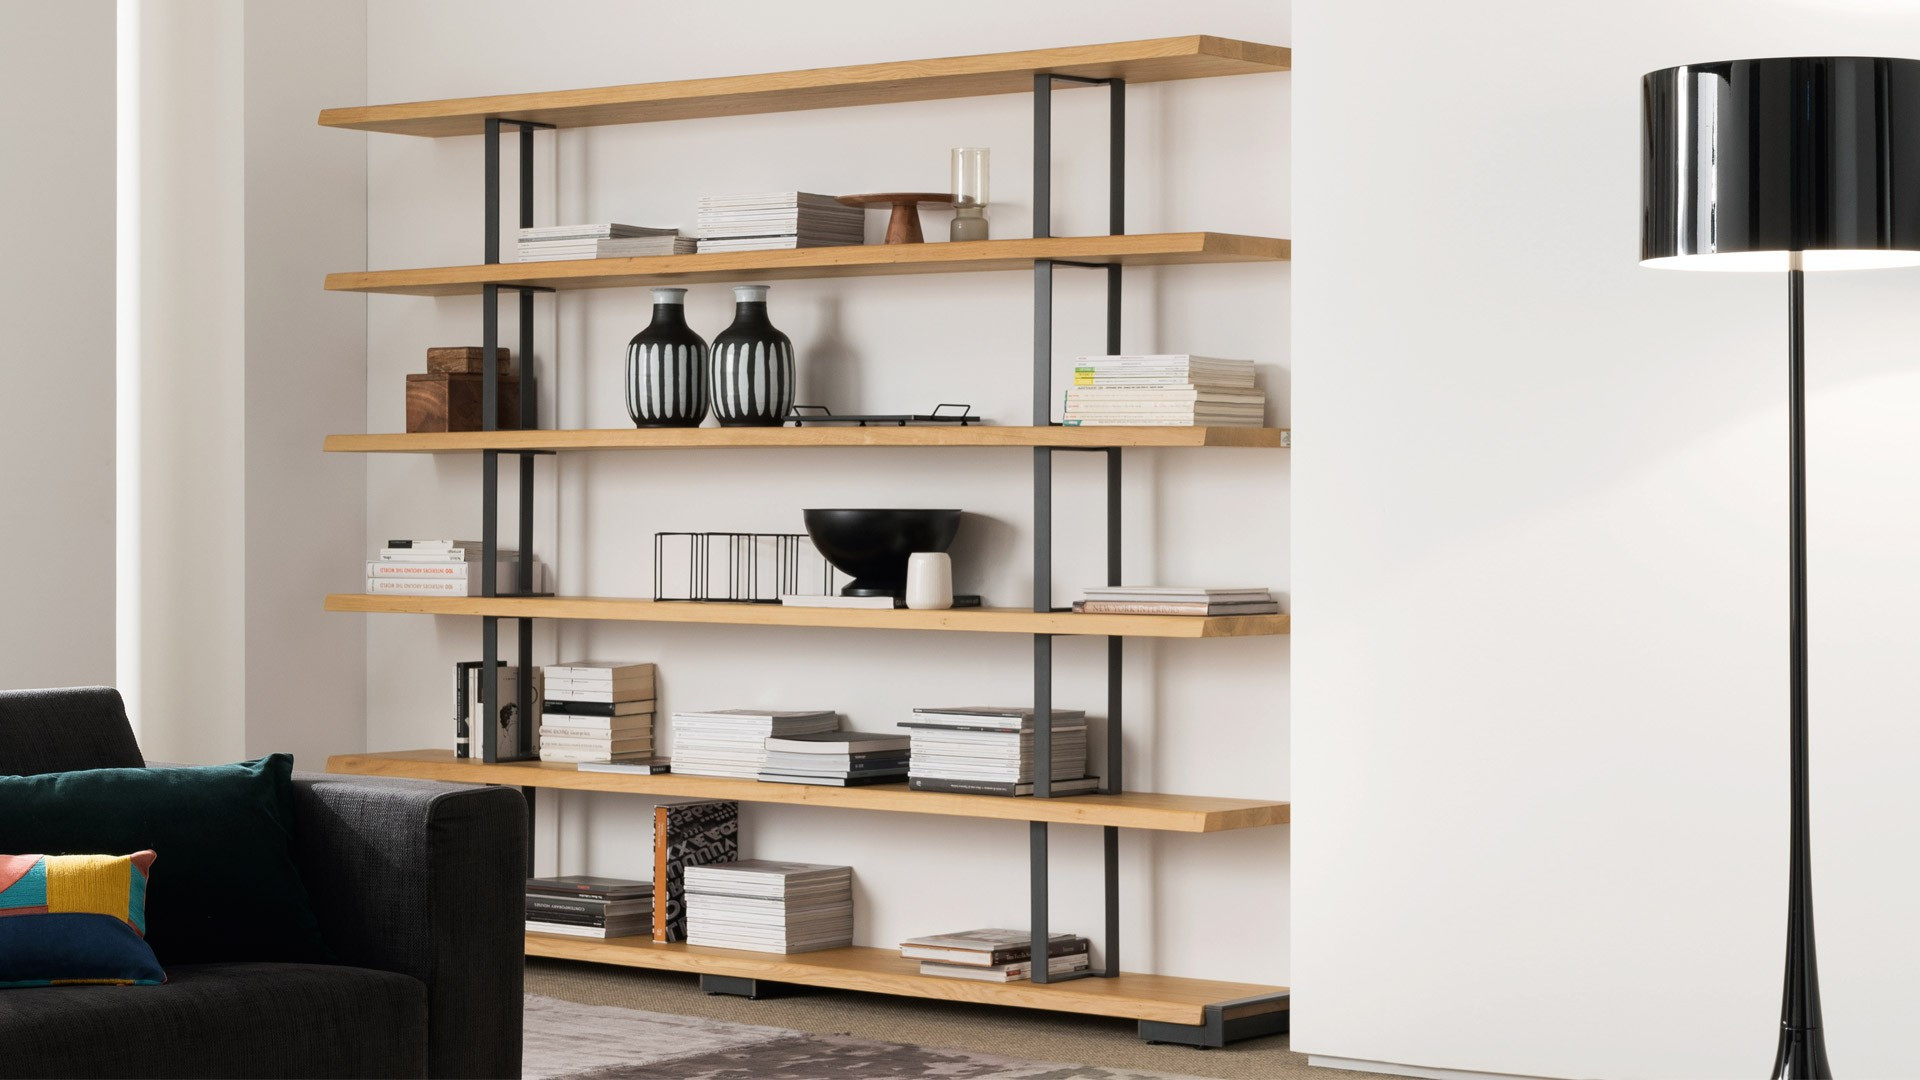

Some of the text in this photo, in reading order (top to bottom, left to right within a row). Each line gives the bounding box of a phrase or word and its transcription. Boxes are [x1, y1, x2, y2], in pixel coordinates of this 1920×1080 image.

[1092, 604, 1180, 614] NEW YORK INTERIORS
[551, 904, 585, 912] CONTEMPORARY
